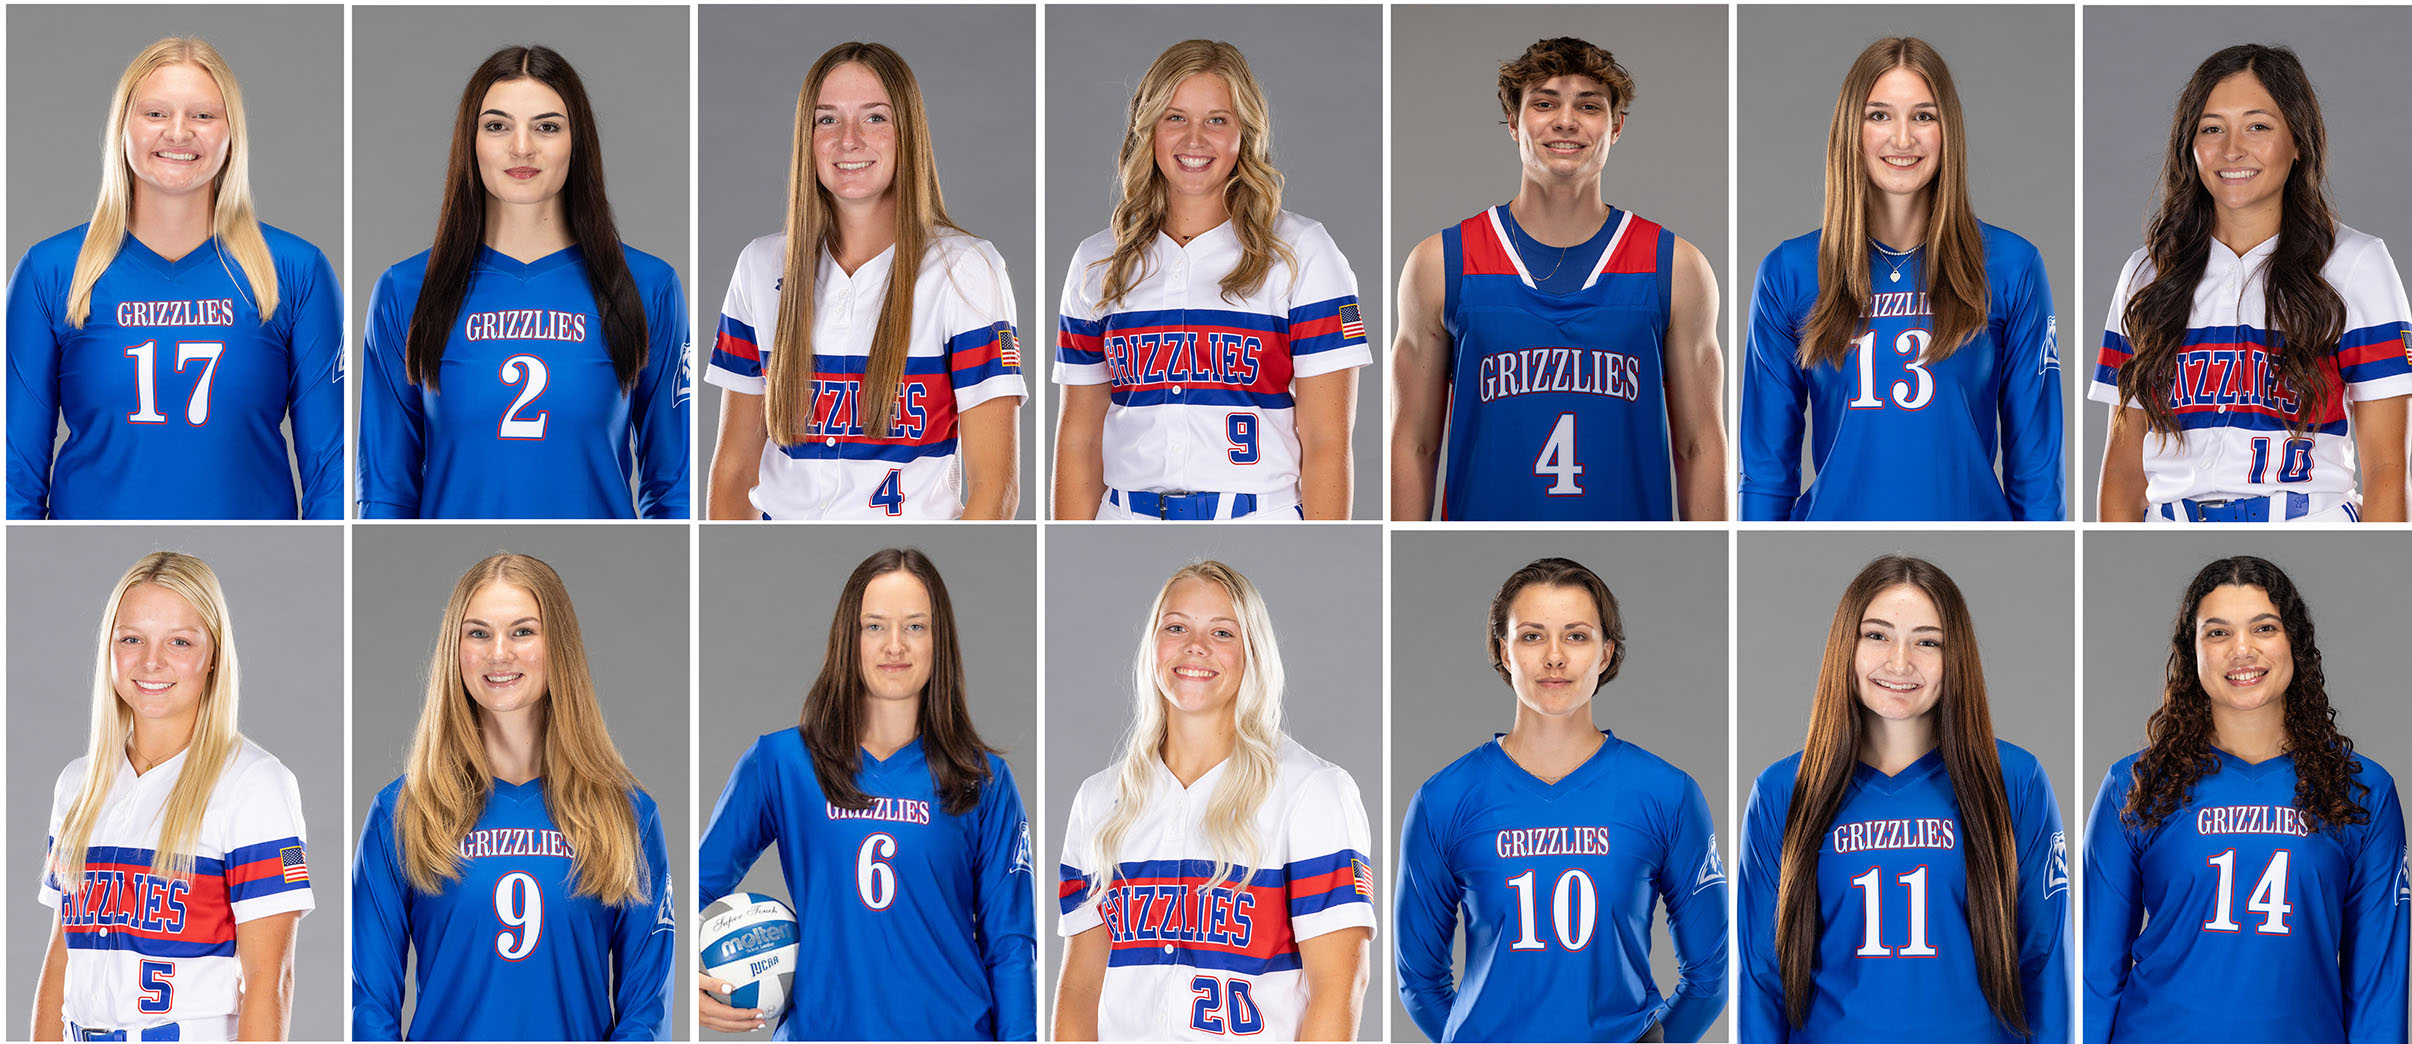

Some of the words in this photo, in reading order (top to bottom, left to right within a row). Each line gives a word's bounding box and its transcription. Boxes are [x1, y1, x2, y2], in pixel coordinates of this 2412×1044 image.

[116, 298, 234, 328] GRIZZLIES
[465, 309, 586, 343] GRIZZLIES
[1859, 291, 1935, 318] IZZLI
[124, 339, 226, 427] 17
[1104, 331, 1263, 388] GRIZZLIES
[1480, 346, 1640, 403] GRIZZLIES
[1848, 327, 1937, 412] 13
[2167, 350, 2304, 415] IZZLIES
[497, 353, 550, 441] 2
[800, 379, 927, 440] ZZLES
[1225, 412, 1261, 466] 9
[1532, 411, 1586, 498] 4
[2248, 437, 2315, 484] 10
[869, 468, 905, 517] 4
[460, 828, 576, 860] GRIZZLIES
[1496, 826, 1610, 858] GRIZZLIES
[1833, 818, 1956, 854] GRIZZLIES
[2197, 805, 2309, 838] GRIZZLIES
[855, 831, 898, 912] 6
[2202, 847, 2294, 937] 14
[492, 869, 545, 963] 9
[1505, 867, 1599, 953] 10
[1850, 864, 1939, 959] 11
[720, 922, 792, 958] molten
[137, 958, 176, 1015] 5
[1189, 974, 1265, 1037] 20
